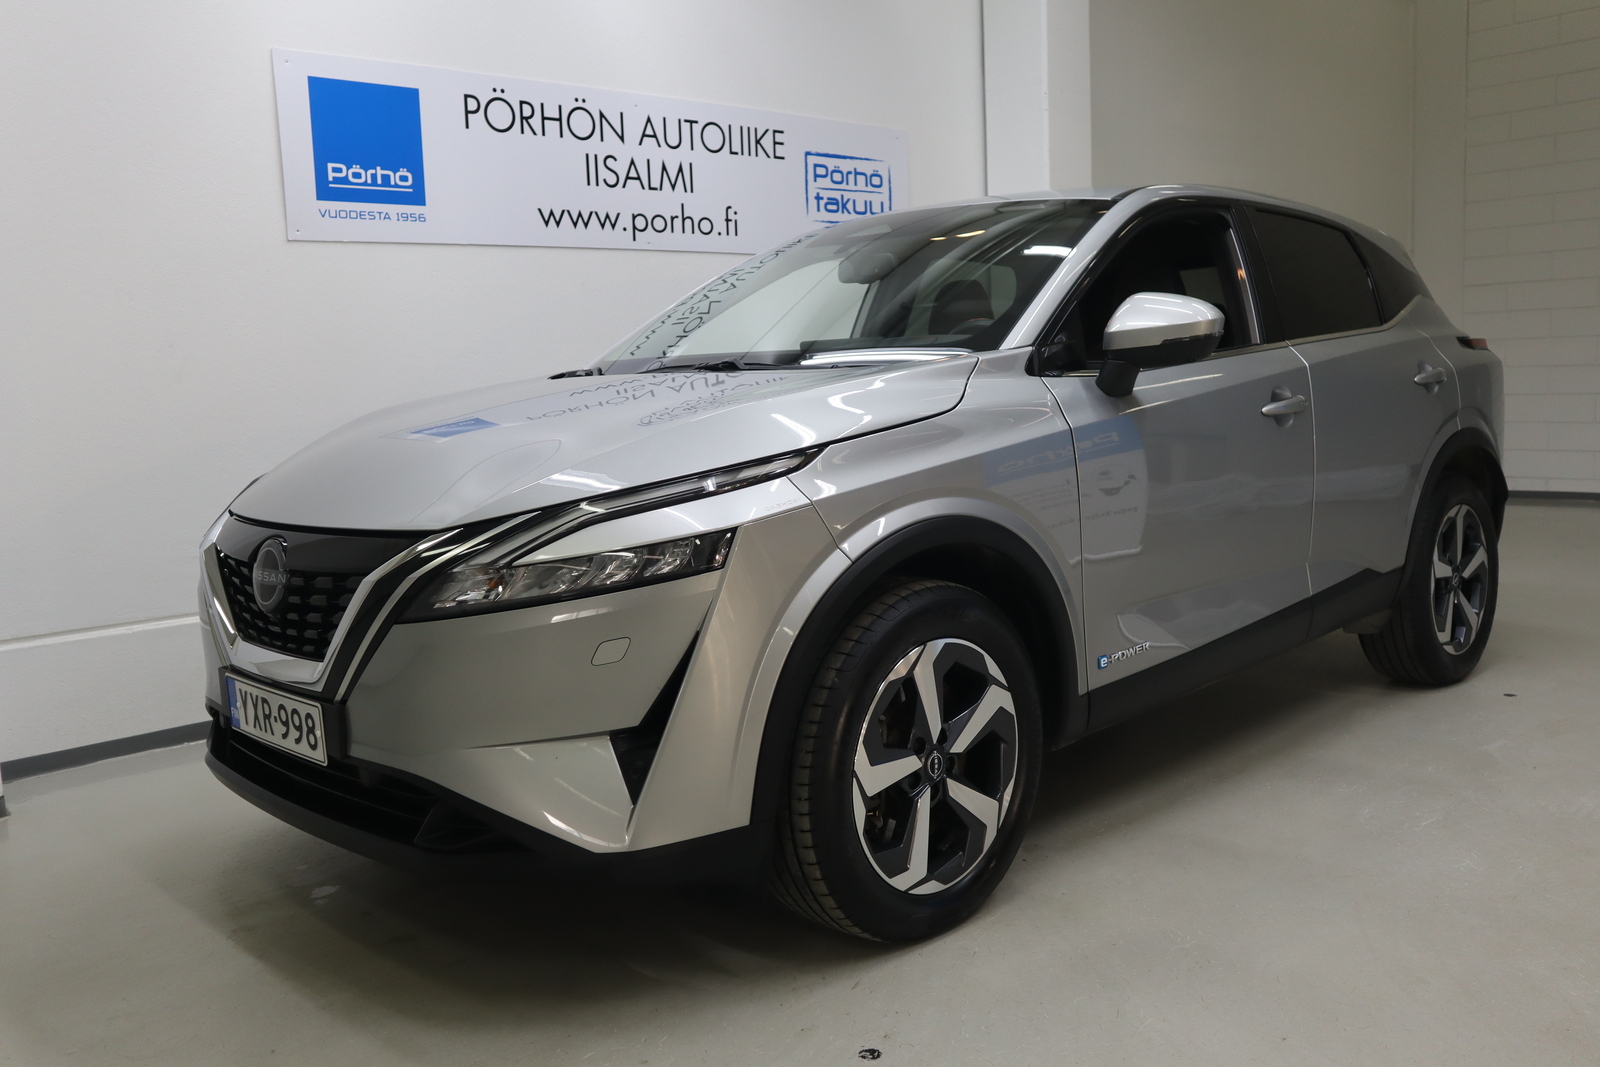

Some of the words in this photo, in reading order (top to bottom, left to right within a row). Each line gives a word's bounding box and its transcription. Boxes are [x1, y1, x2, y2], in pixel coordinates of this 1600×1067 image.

[463, 87, 625, 144] PÖRHÖN
[638, 114, 786, 160] AUTOLIIKE
[327, 162, 413, 187] Pörhö
[585, 153, 694, 193] IISALMI
[813, 162, 884, 189] Pörhö
[318, 208, 392, 222] VUODESTA
[396, 212, 427, 223] 1956
[814, 192, 885, 215] takuu
[537, 202, 739, 242] www.porho.fi
[1099, 641, 1150, 668] e-POWER
[237, 687, 319, 752] YXR-998
